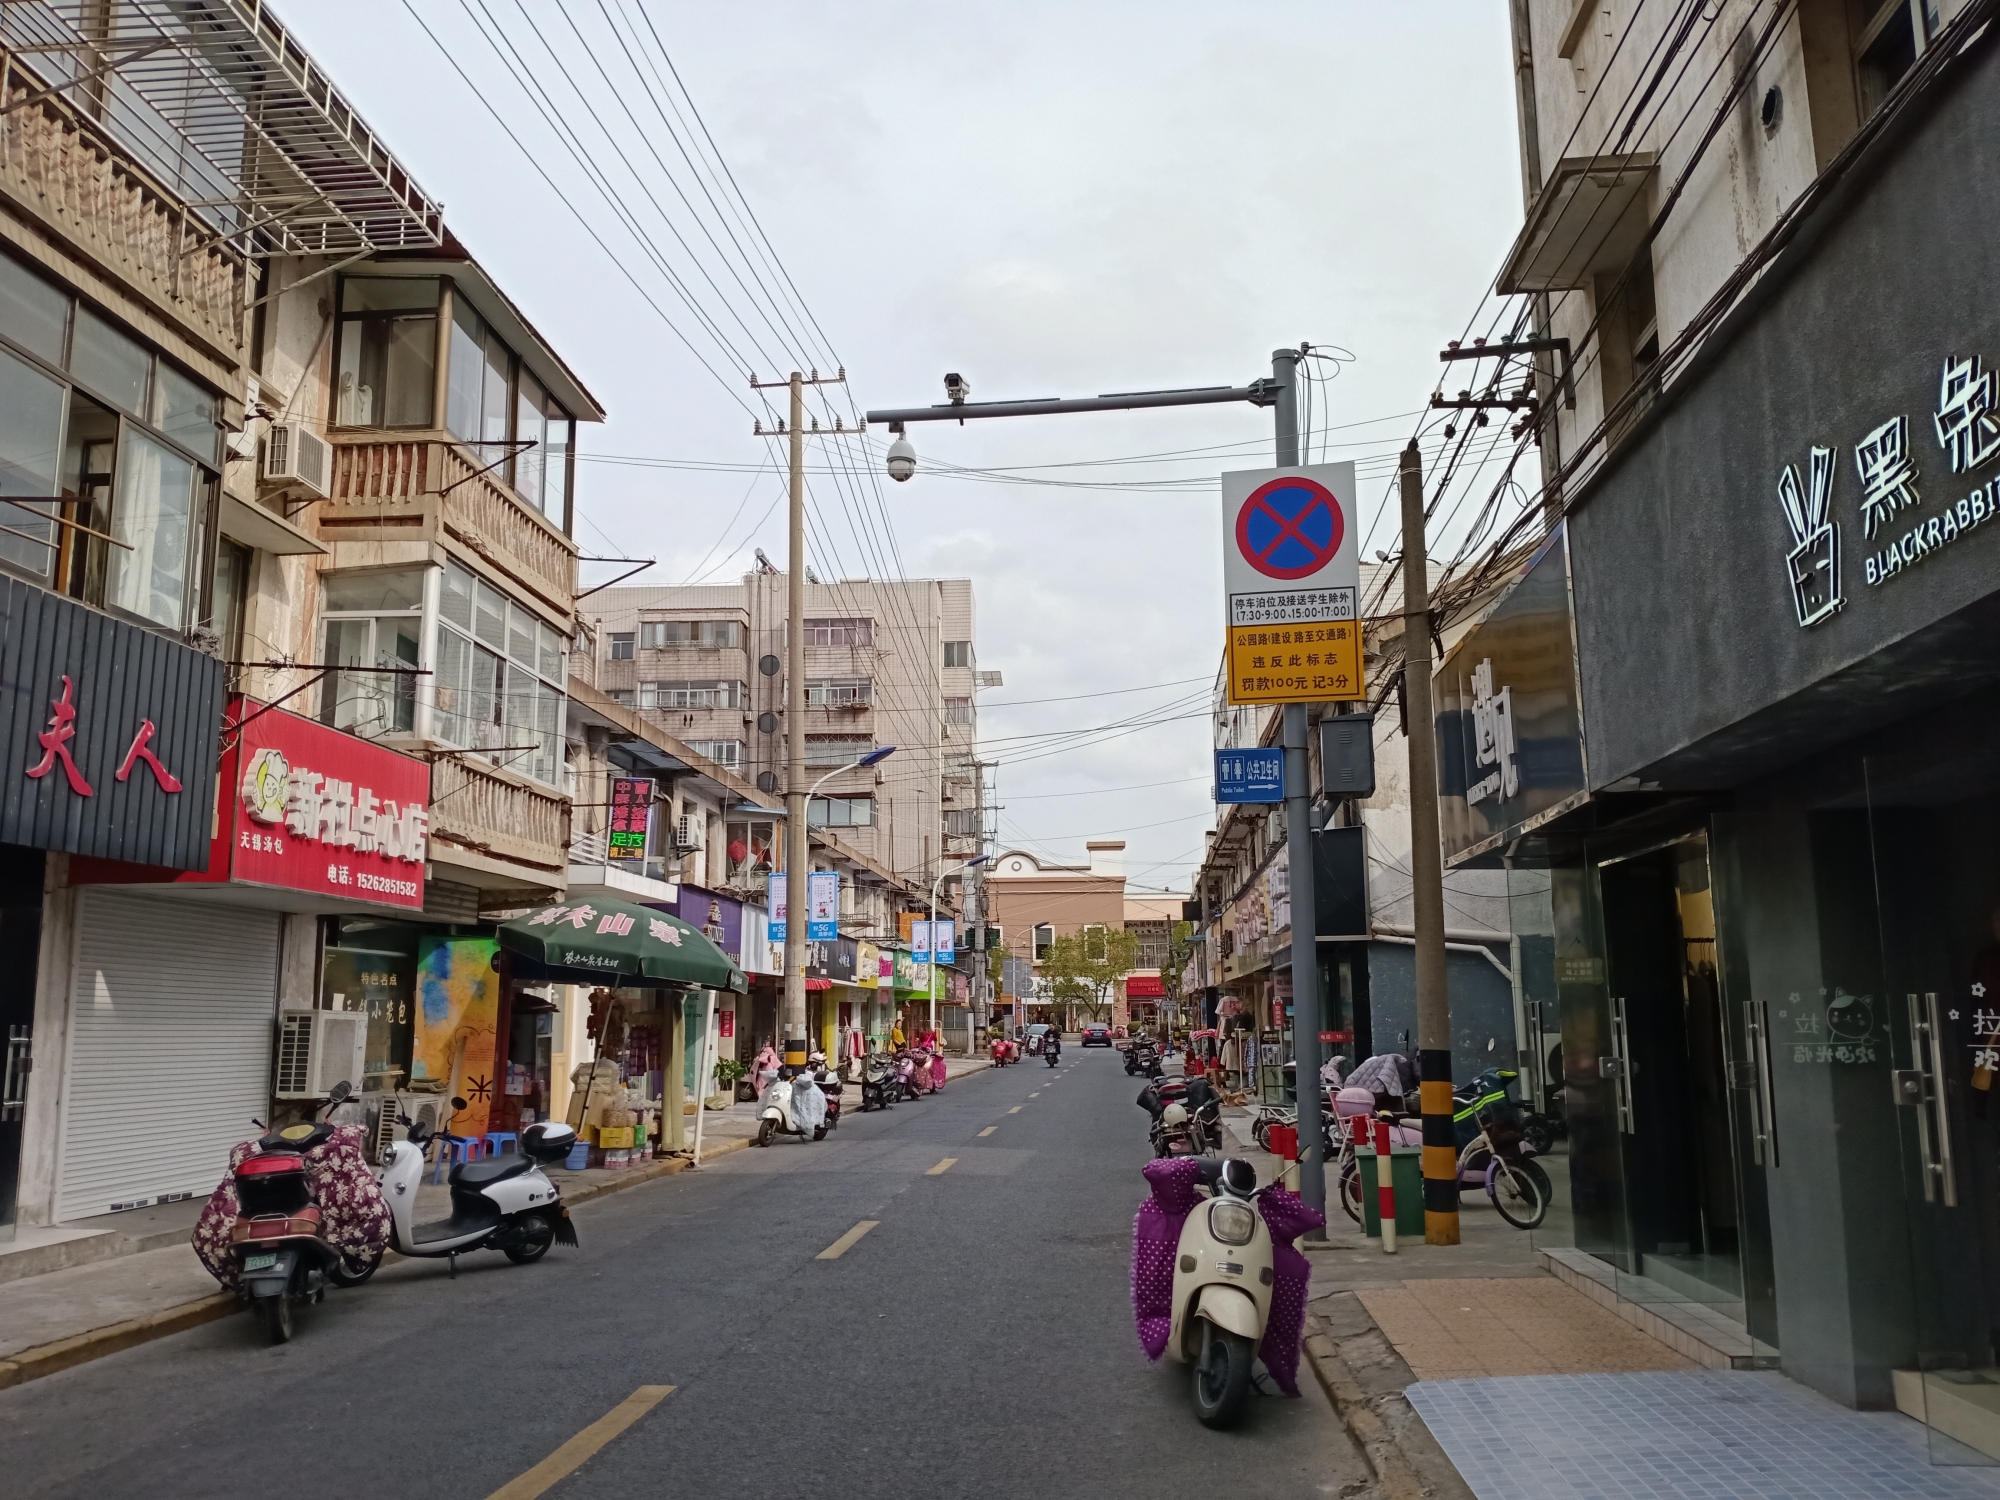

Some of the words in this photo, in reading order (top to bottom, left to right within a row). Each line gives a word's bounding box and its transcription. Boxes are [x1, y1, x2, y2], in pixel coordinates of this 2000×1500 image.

[1235, 593, 1350, 610] 停车泊位及接送学生除外
[1252, 652, 1338, 668] 违反此标志
[1242, 676, 1308, 692] 罚款100元
[1313, 674, 1349, 690] 记3分
[26, 675, 183, 797] 夫人
[1246, 759, 1280, 781] 公共卫生间
[1233, 786, 1245, 794] Toilet
[285, 766, 429, 865] 新村点心店
[240, 831, 283, 855] 无锡汤包
[610, 833, 645, 847] 足疗
[562, 950, 620, 968] 农夫山泉有点甜
[361, 972, 397, 986] 特色名点
